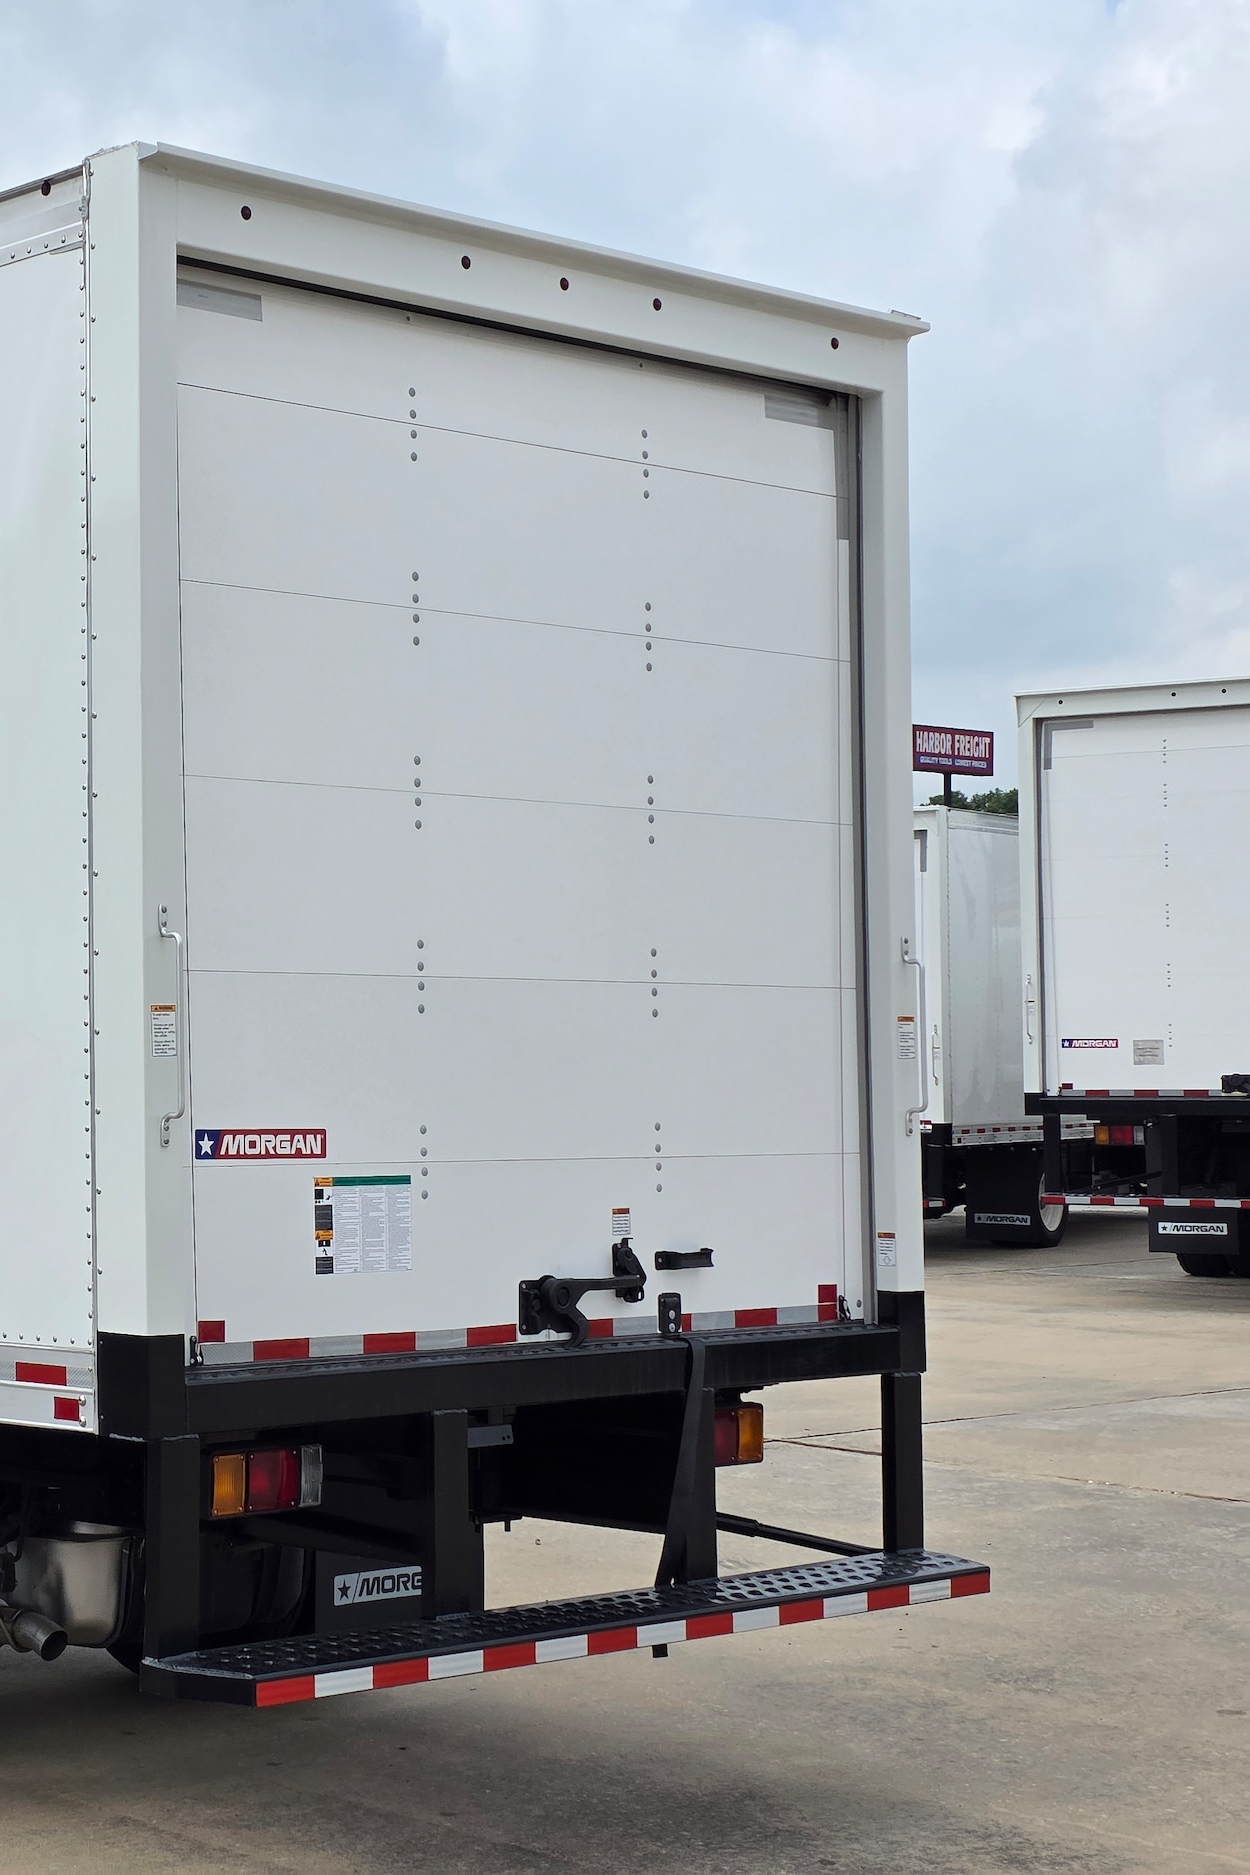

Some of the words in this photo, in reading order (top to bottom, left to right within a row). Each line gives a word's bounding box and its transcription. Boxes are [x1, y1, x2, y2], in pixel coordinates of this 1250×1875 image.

[916, 731, 952, 755] HARBOR
[955, 734, 990, 758] FREIGHT
[1071, 1039, 1117, 1048] MORGAN
[220, 1134, 322, 1155] MORGAN
[986, 1215, 1028, 1224] MORGAN
[1172, 1224, 1224, 1233] MORGAN
[358, 1572, 422, 1597] MORG
